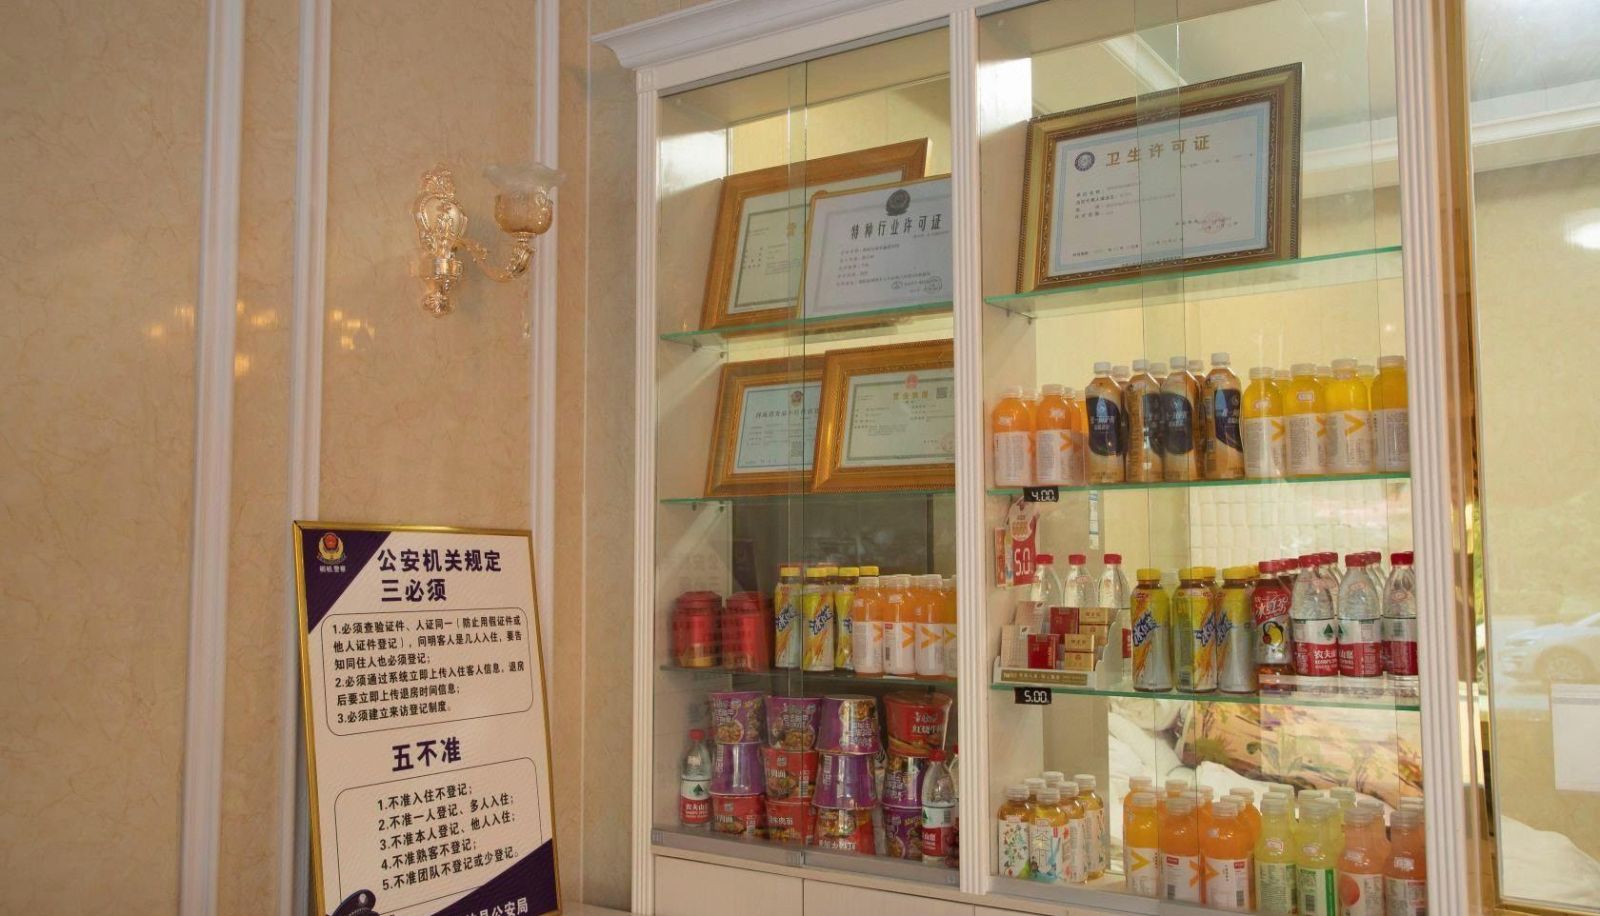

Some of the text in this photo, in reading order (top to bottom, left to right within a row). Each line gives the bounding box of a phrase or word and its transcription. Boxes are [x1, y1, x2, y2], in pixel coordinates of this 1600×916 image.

[1105, 134, 1211, 167] 卫生许可证
[851, 213, 943, 240] 特种行业许可证
[1031, 489, 1055, 502] 4.00
[377, 549, 502, 573] 公安机关规定
[381, 578, 447, 602] 三必须
[335, 652, 431, 671] 知同住人也必须登记；
[337, 684, 460, 707] 后要立即上传退房时间信息；
[1024, 690, 1048, 703] 5.00
[337, 701, 453, 724] 3.必须建立来访登记制度。
[391, 736, 462, 772] 五不准
[377, 783, 473, 811] 1.不准入住不登记；
[378, 794, 515, 831] 2.不准一人登记、多人入住；
[379, 811, 516, 851] 3.不准本人登记、他人入住；
[381, 839, 477, 871] 4.不准熟客不登记；
[382, 847, 519, 891] 5.不准团队不登记或少登记。
